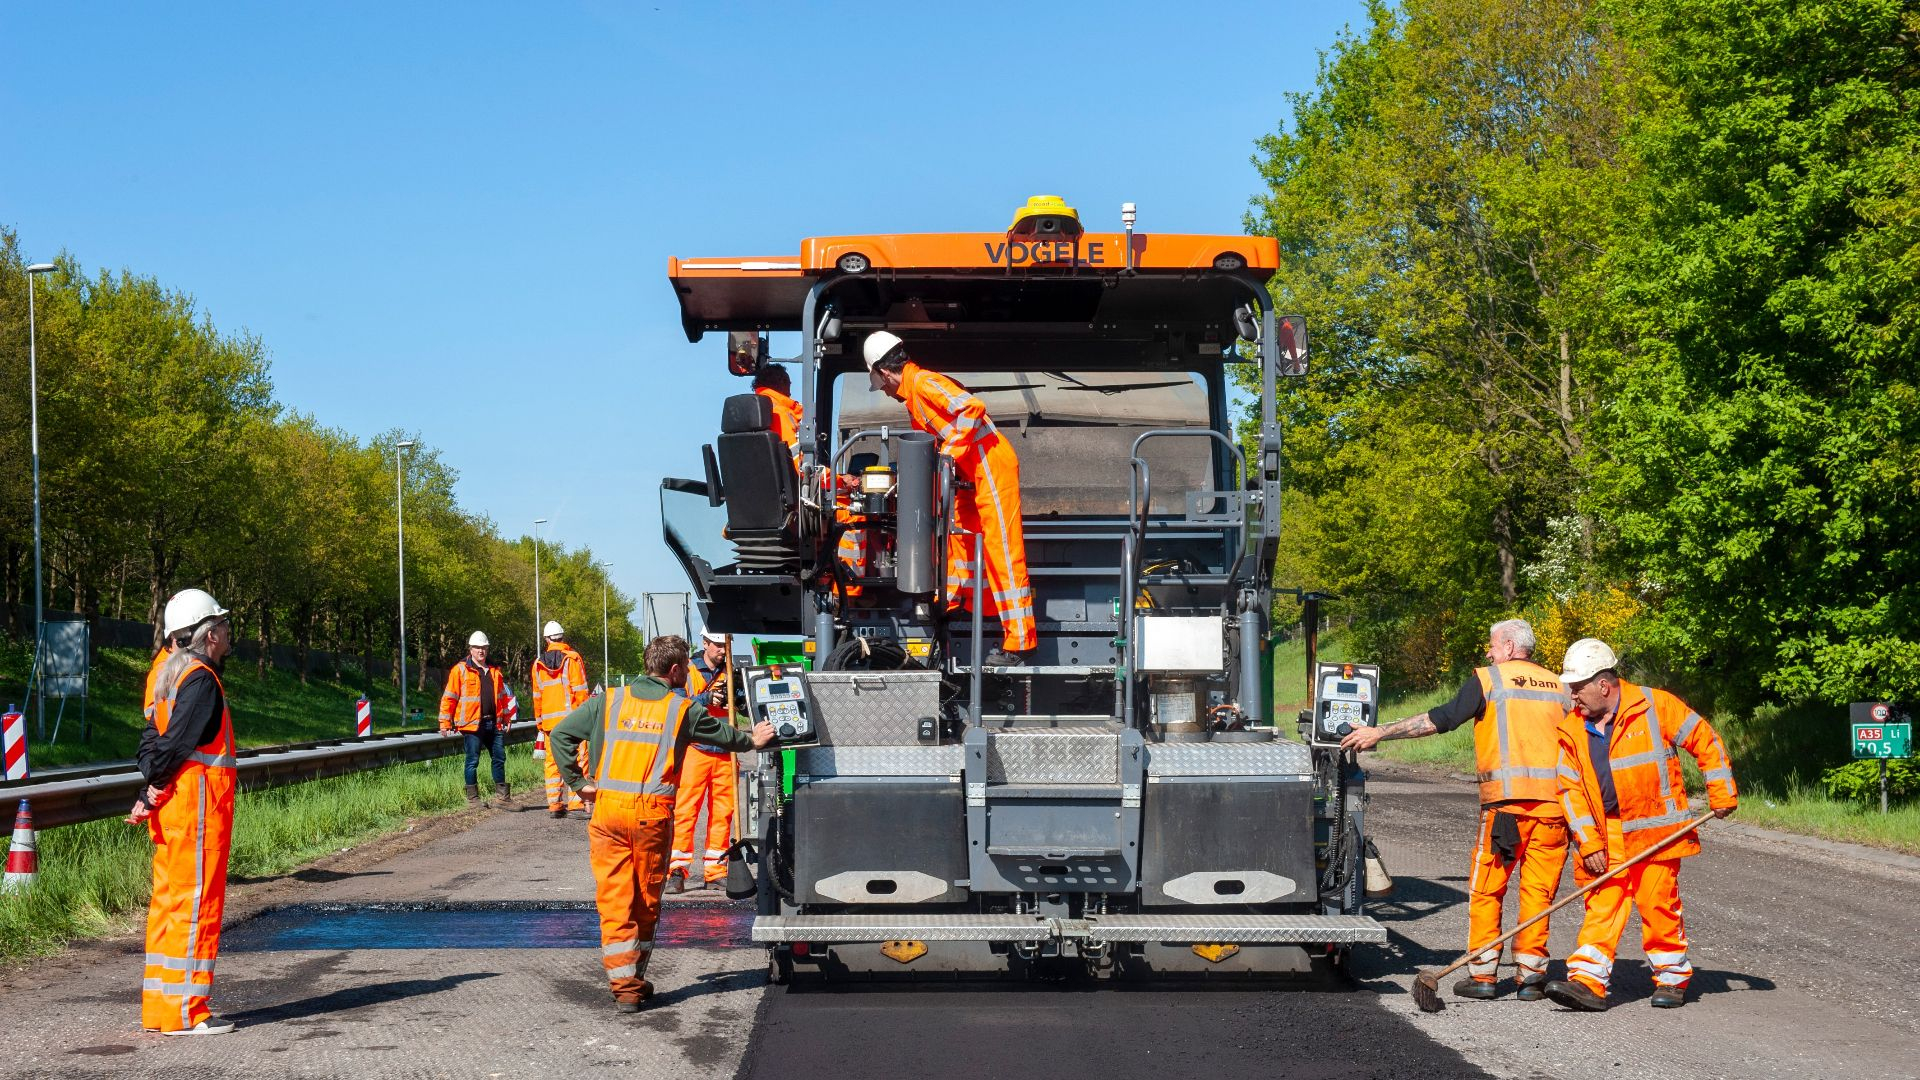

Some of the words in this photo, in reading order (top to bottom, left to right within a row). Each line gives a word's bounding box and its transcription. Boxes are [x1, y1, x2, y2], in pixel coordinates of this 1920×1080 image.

[1529, 676, 1558, 689] bam
[1859, 729, 1881, 739] A35
[1890, 729, 1900, 739] Li
[1857, 742, 1892, 756] 70,5
